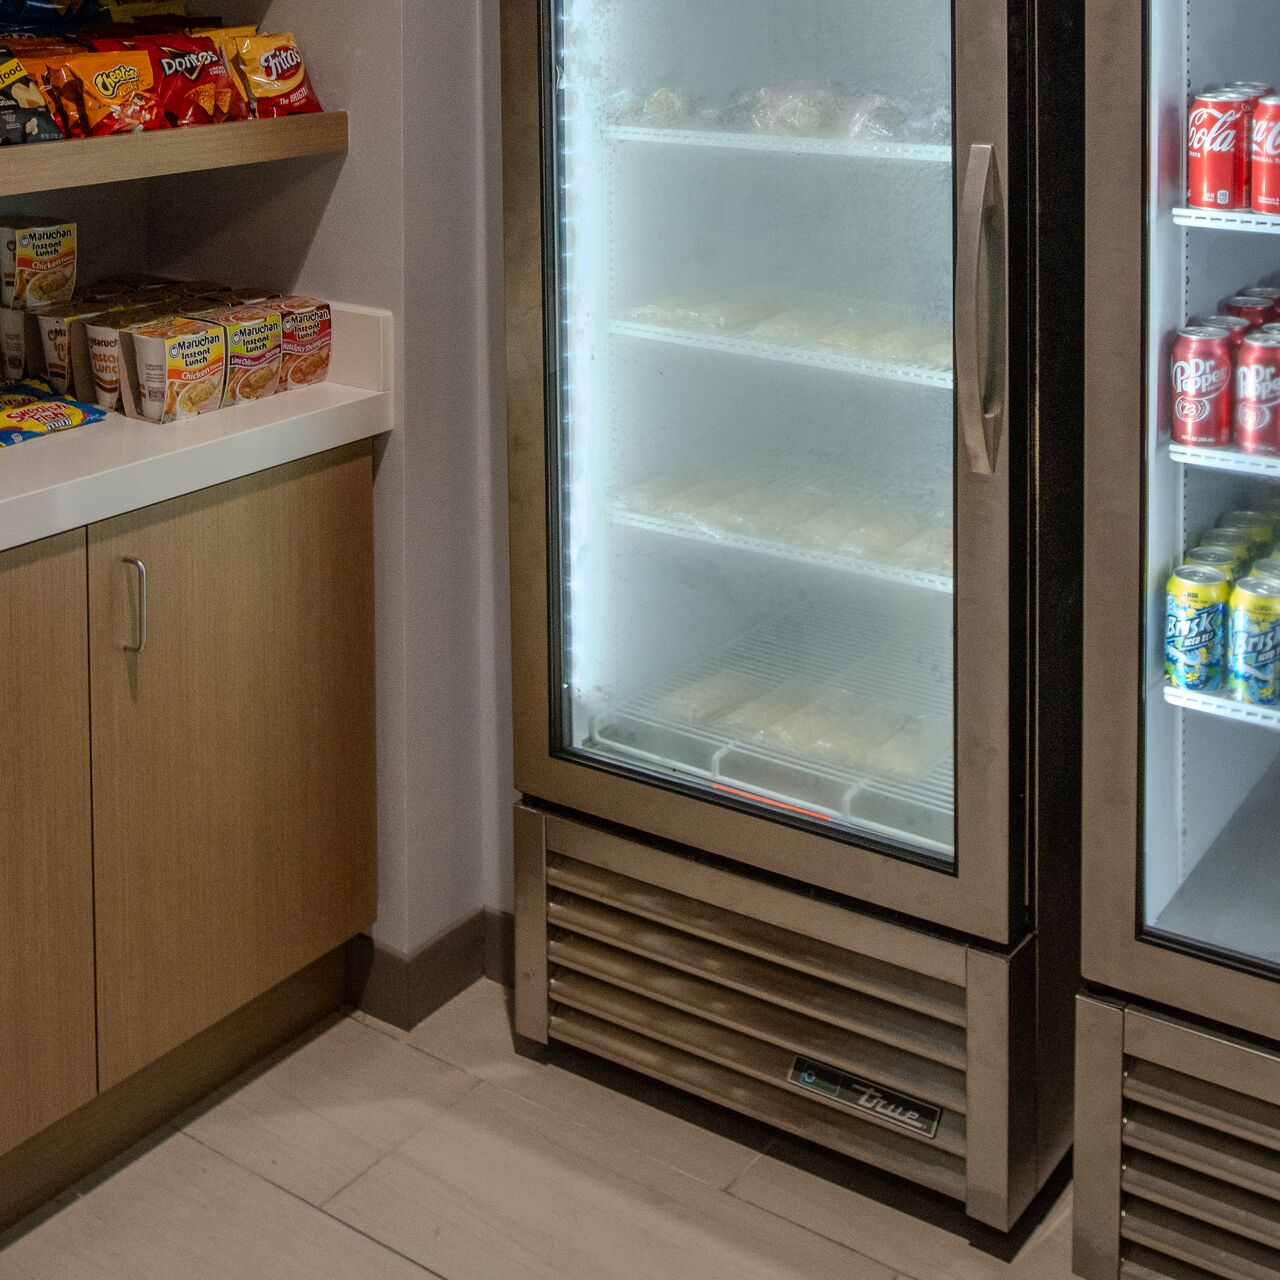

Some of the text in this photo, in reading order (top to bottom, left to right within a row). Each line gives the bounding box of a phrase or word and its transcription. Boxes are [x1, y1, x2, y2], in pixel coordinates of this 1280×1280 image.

[161, 49, 219, 76] Doritos
[260, 46, 301, 81] Fritos
[29, 229, 72, 241] Maruchan
[32, 241, 62, 250] Instant
[35, 248, 59, 257] Lunch
[31, 260, 61, 270] Chicken
[291, 309, 330, 324] Maruchan
[239, 322, 278, 338] Maruchan
[294, 321, 320, 333] Instant
[242, 334, 270, 347] Instant
[297, 330, 319, 340] Lunch
[177, 334, 220, 351] Maruchan
[246, 343, 267, 353] Lunch
[181, 347, 211, 360] Instant
[185, 355, 208, 368] Lunch
[1191, 358, 1215, 375] Dr
[181, 368, 209, 380] Chicken
[1173, 360, 1226, 395] Pepper
[1251, 365, 1276, 381] Dr
[6, 403, 68, 424] Swedish
[1182, 402, 1197, 416] 23
[29, 411, 66, 424] Fish
[1167, 612, 1216, 639] Brisk
